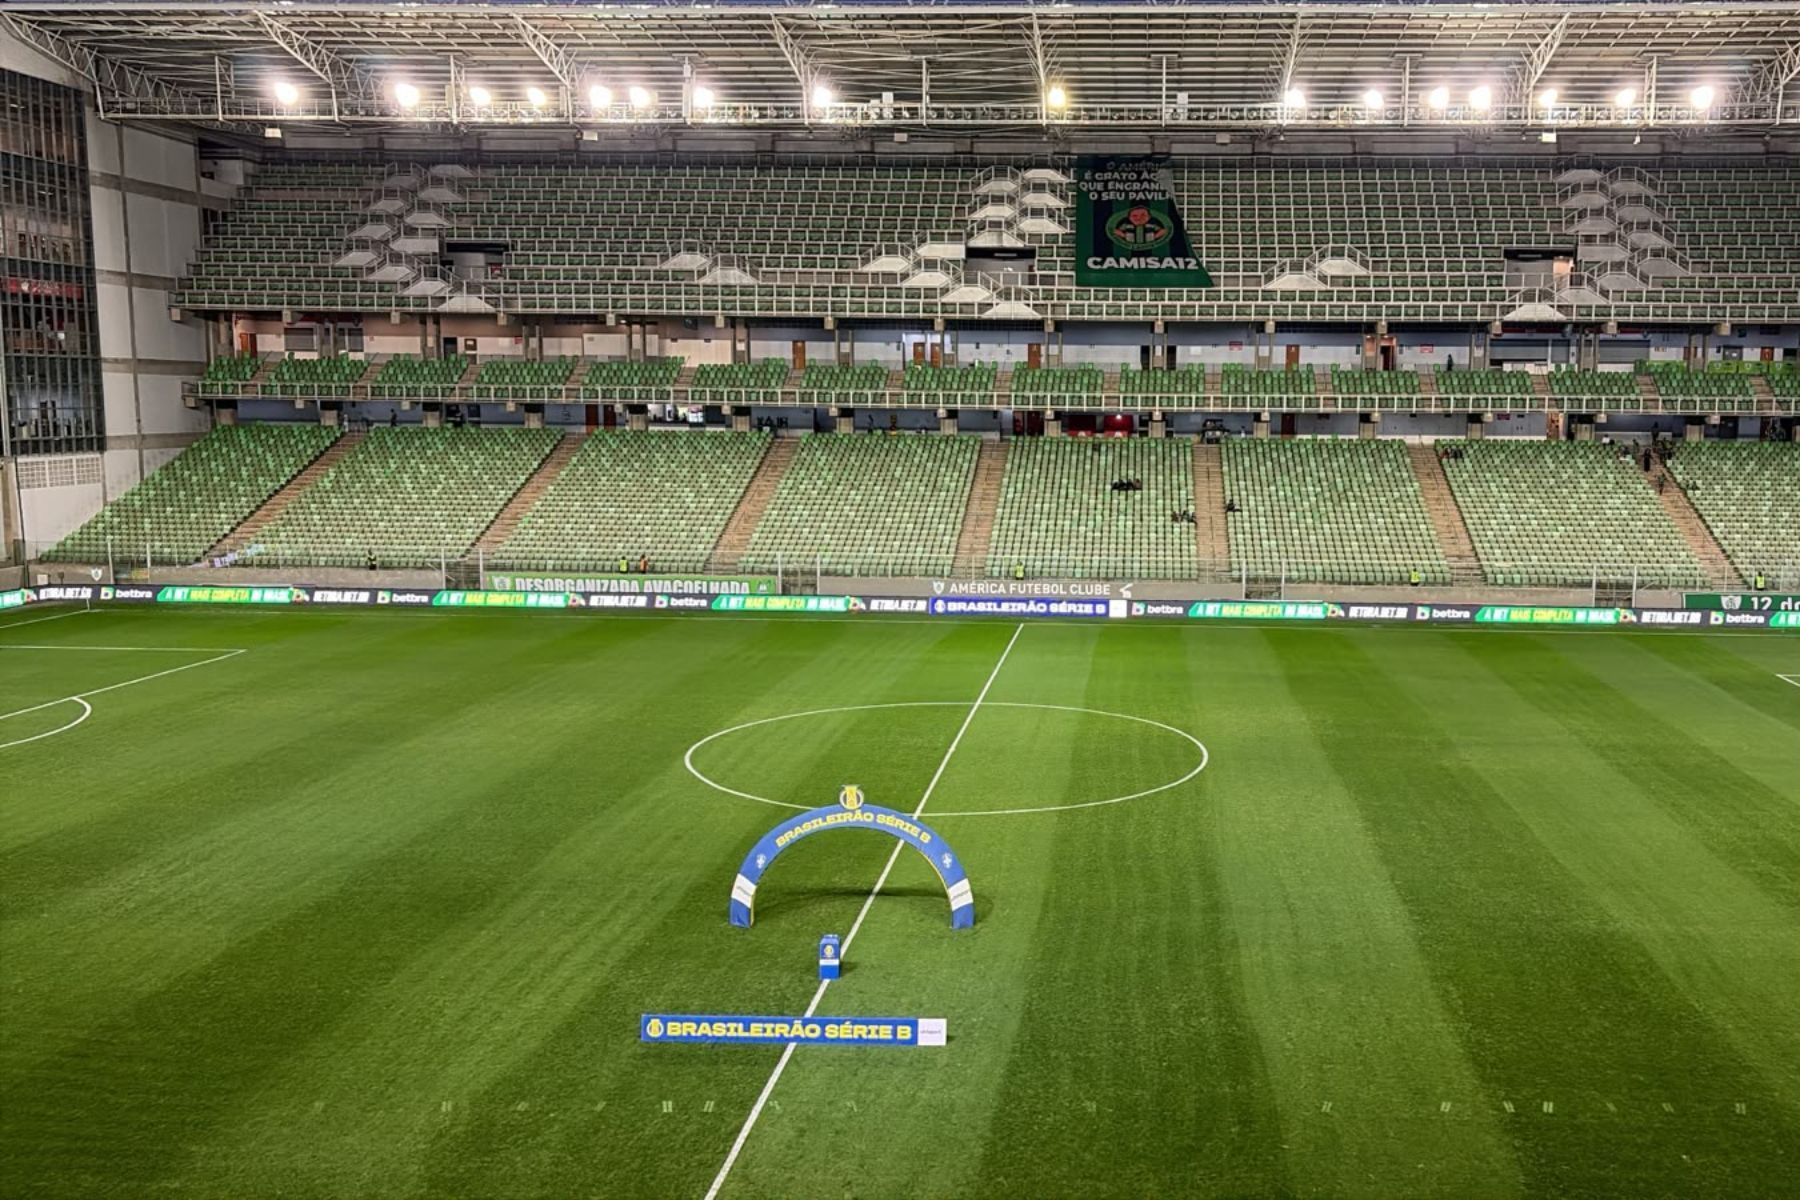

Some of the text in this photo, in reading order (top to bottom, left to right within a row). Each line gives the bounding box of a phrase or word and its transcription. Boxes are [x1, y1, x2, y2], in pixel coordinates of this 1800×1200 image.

[1080, 182, 1104, 191] QUE
[1089, 191, 1098, 200] O
[1101, 191, 1125, 200] SEU
[1087, 256, 1199, 270] CAMISA12
[950, 581, 1110, 596] AMÉRICA FUTEBOL CLUBE
[947, 600, 1047, 613] BRASILEIRÃO
[1049, 601, 1090, 614] SÉRIE
[775, 809, 874, 848] BRASILEIRÃO
[876, 814, 921, 838] SÉRIE
[666, 1020, 912, 1040] BRASILEIRÃO SÉRIE B
